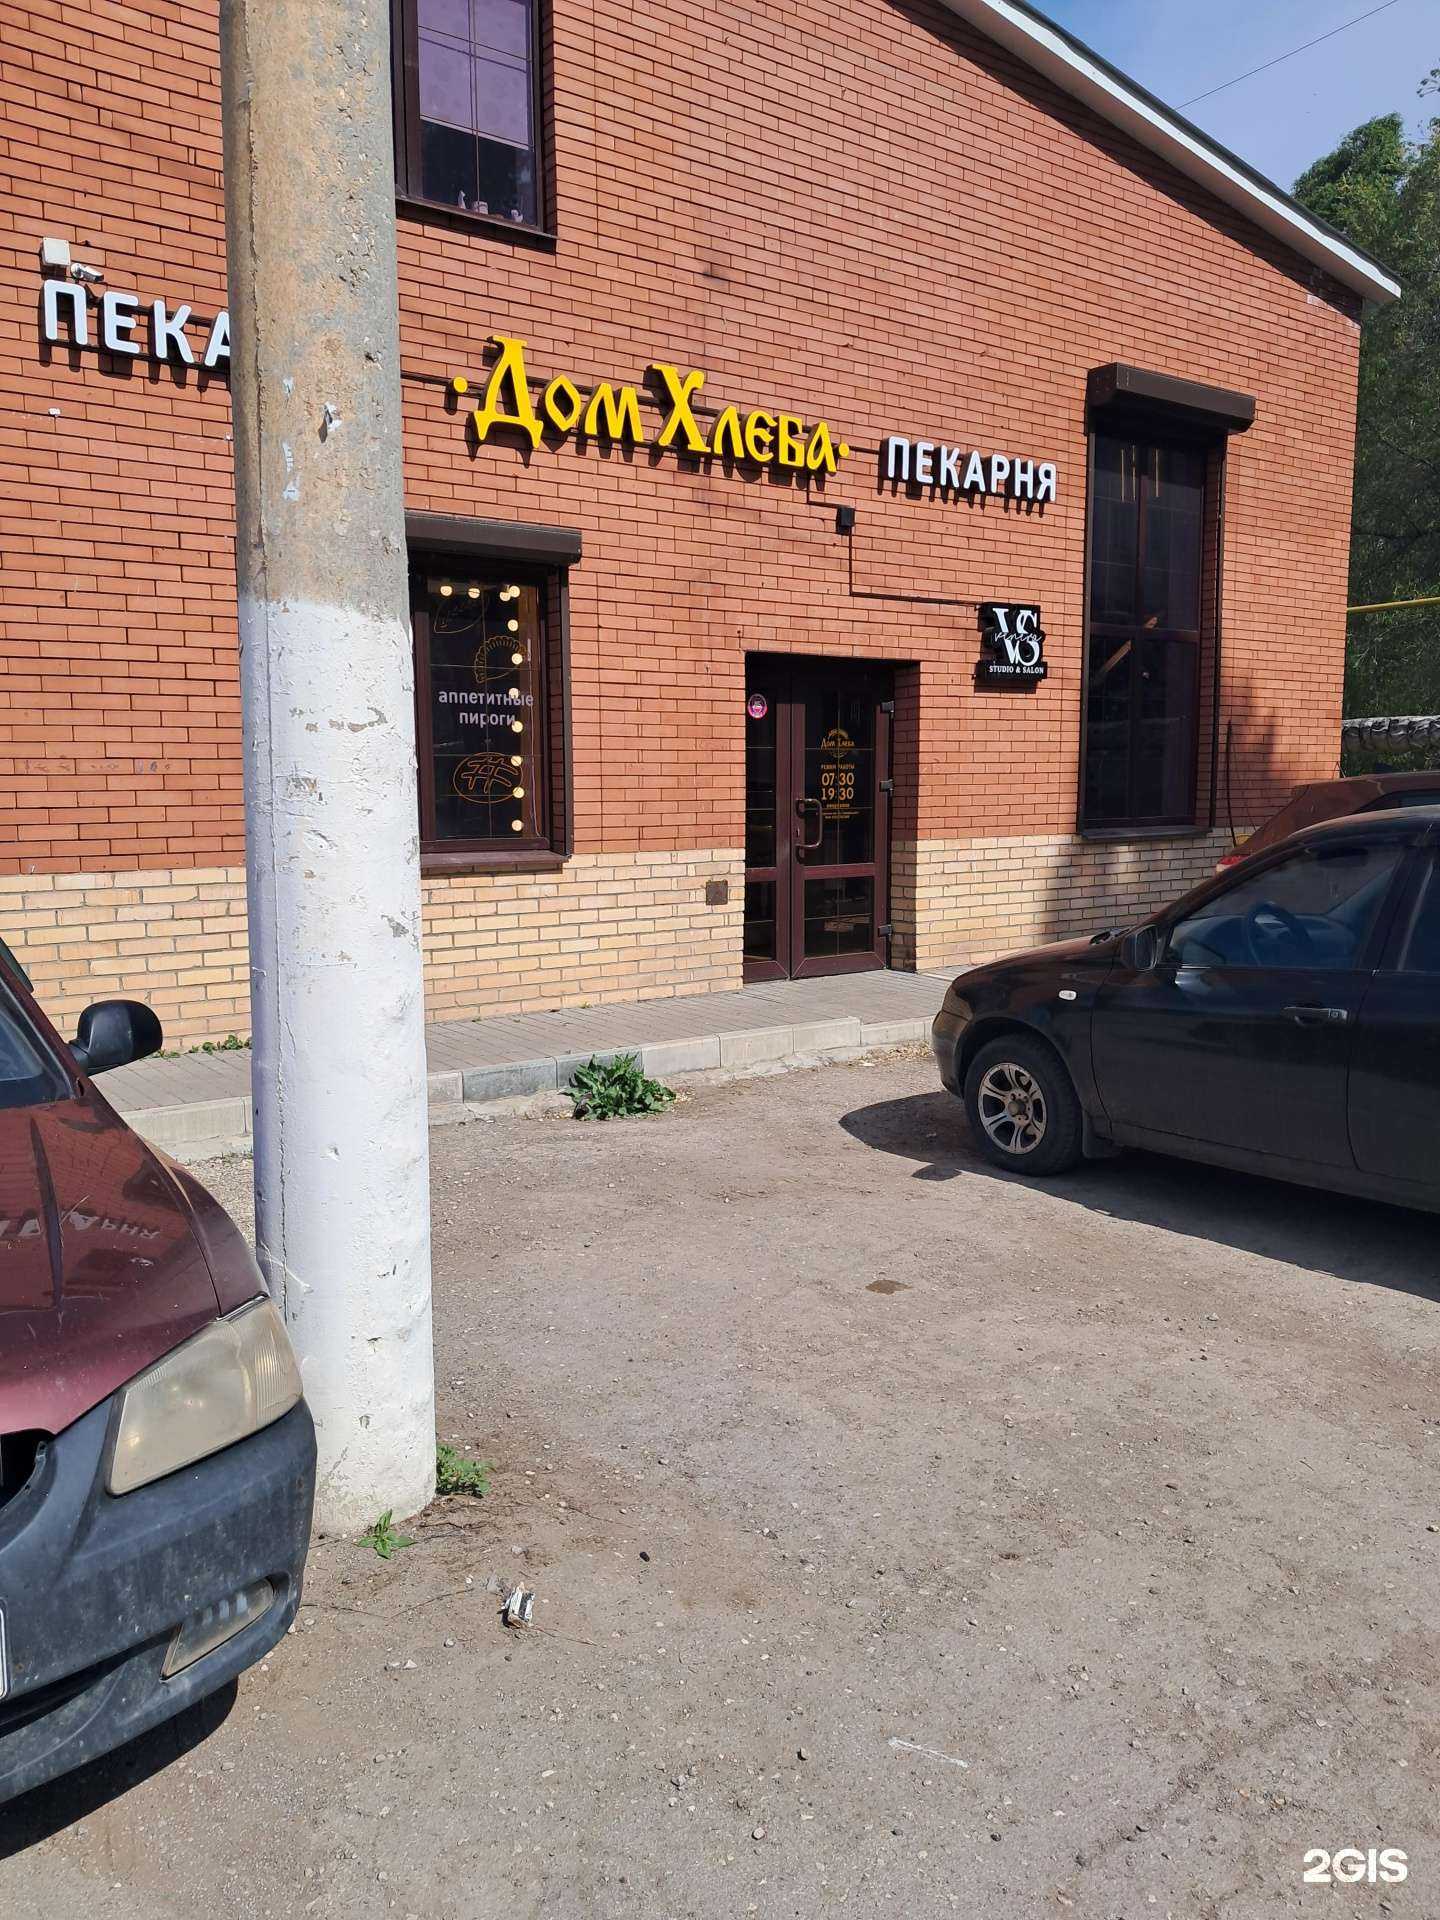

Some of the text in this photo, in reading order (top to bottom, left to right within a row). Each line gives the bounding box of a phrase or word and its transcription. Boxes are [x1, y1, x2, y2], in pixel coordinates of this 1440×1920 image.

[887, 436, 1057, 502] ПЕКАРНЯ
[989, 665, 1014, 673] STUDIO
[1022, 666, 1044, 674] SALON
[438, 690, 534, 706] аппетитные
[459, 712, 516, 728] пироги
